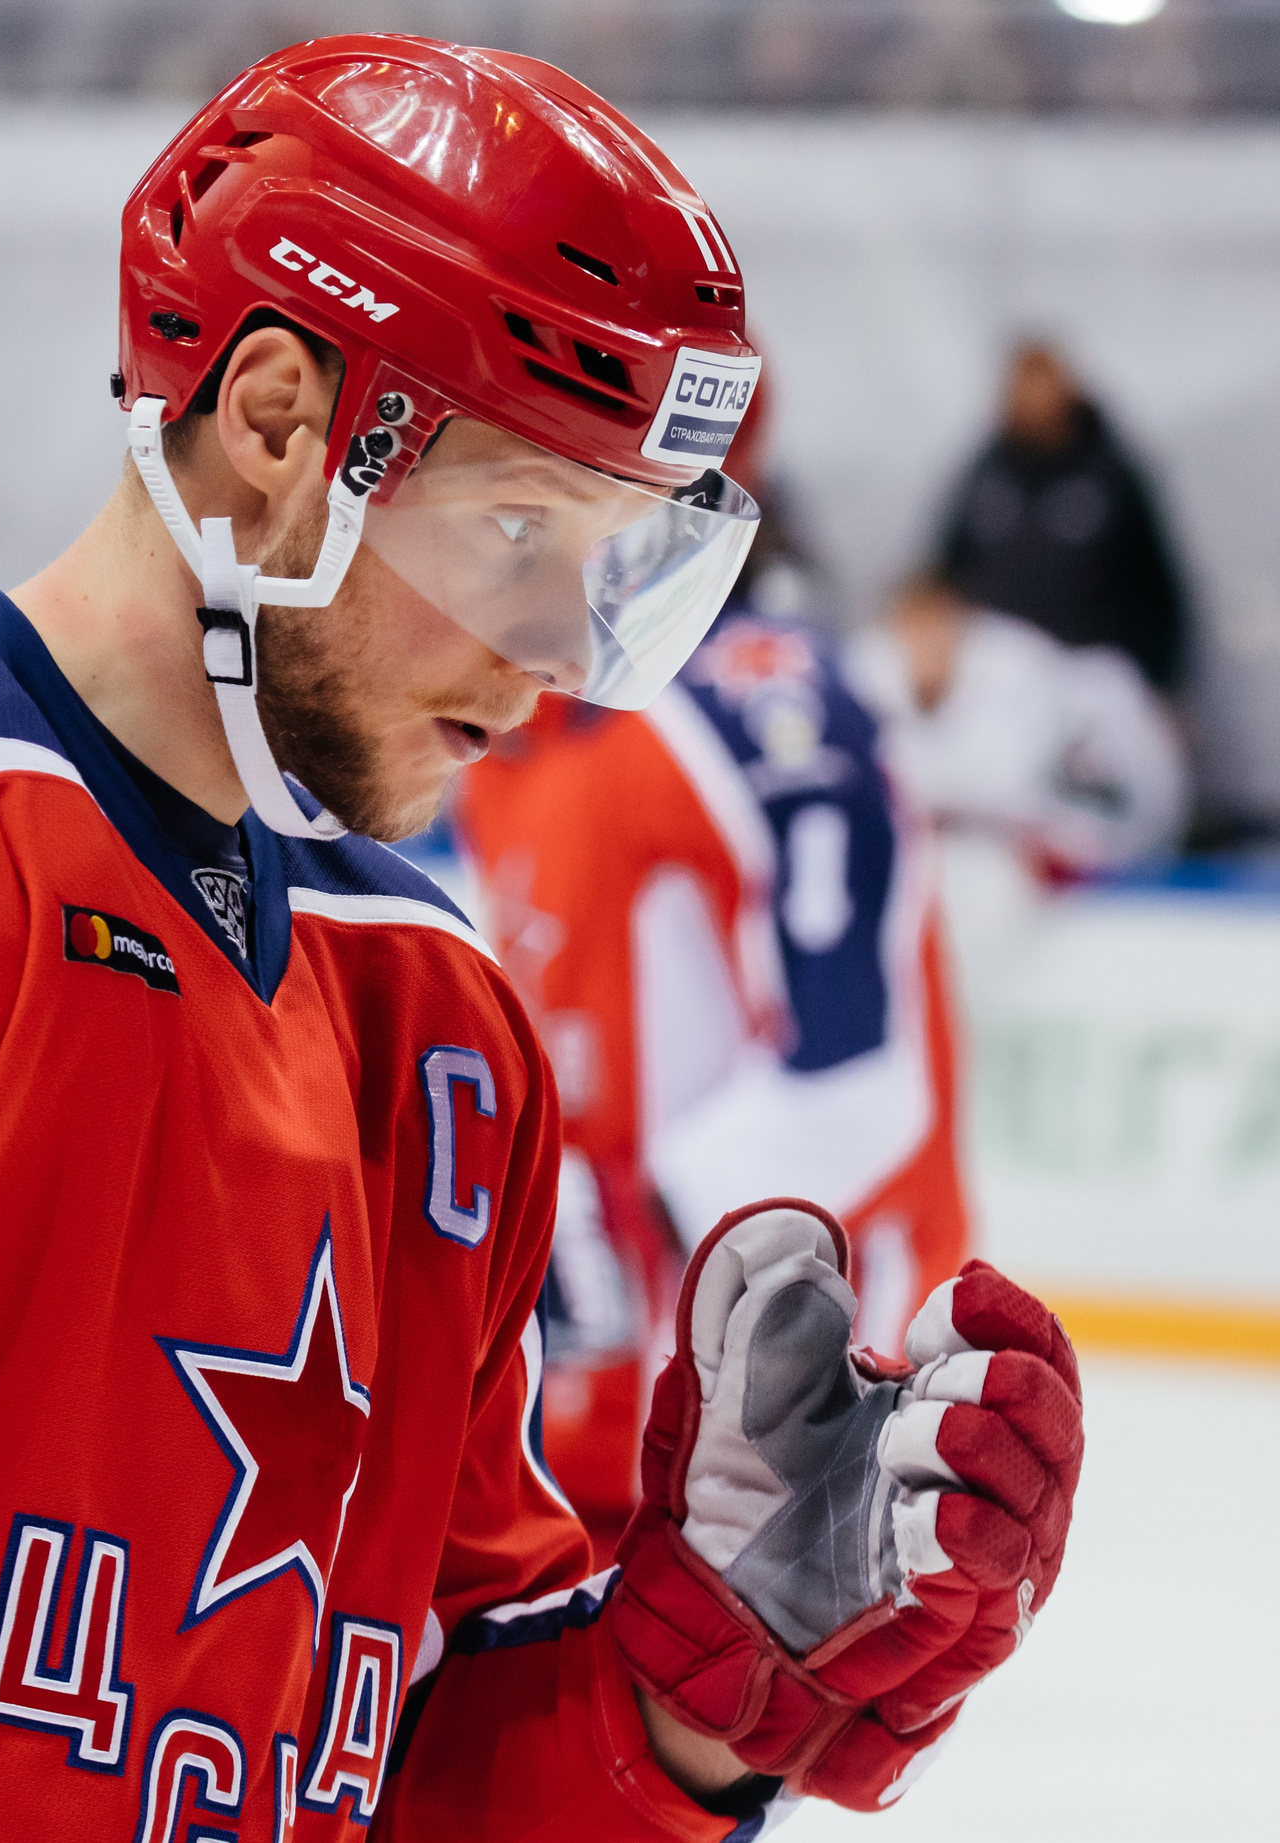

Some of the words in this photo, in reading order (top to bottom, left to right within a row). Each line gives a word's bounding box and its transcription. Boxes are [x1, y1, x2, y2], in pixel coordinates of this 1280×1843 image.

[269, 236, 401, 323] CCM
[674, 372, 751, 411] СОГАЗ
[670, 426, 715, 443] СТРАХОВАЯ
[420, 1044, 497, 1249] C
